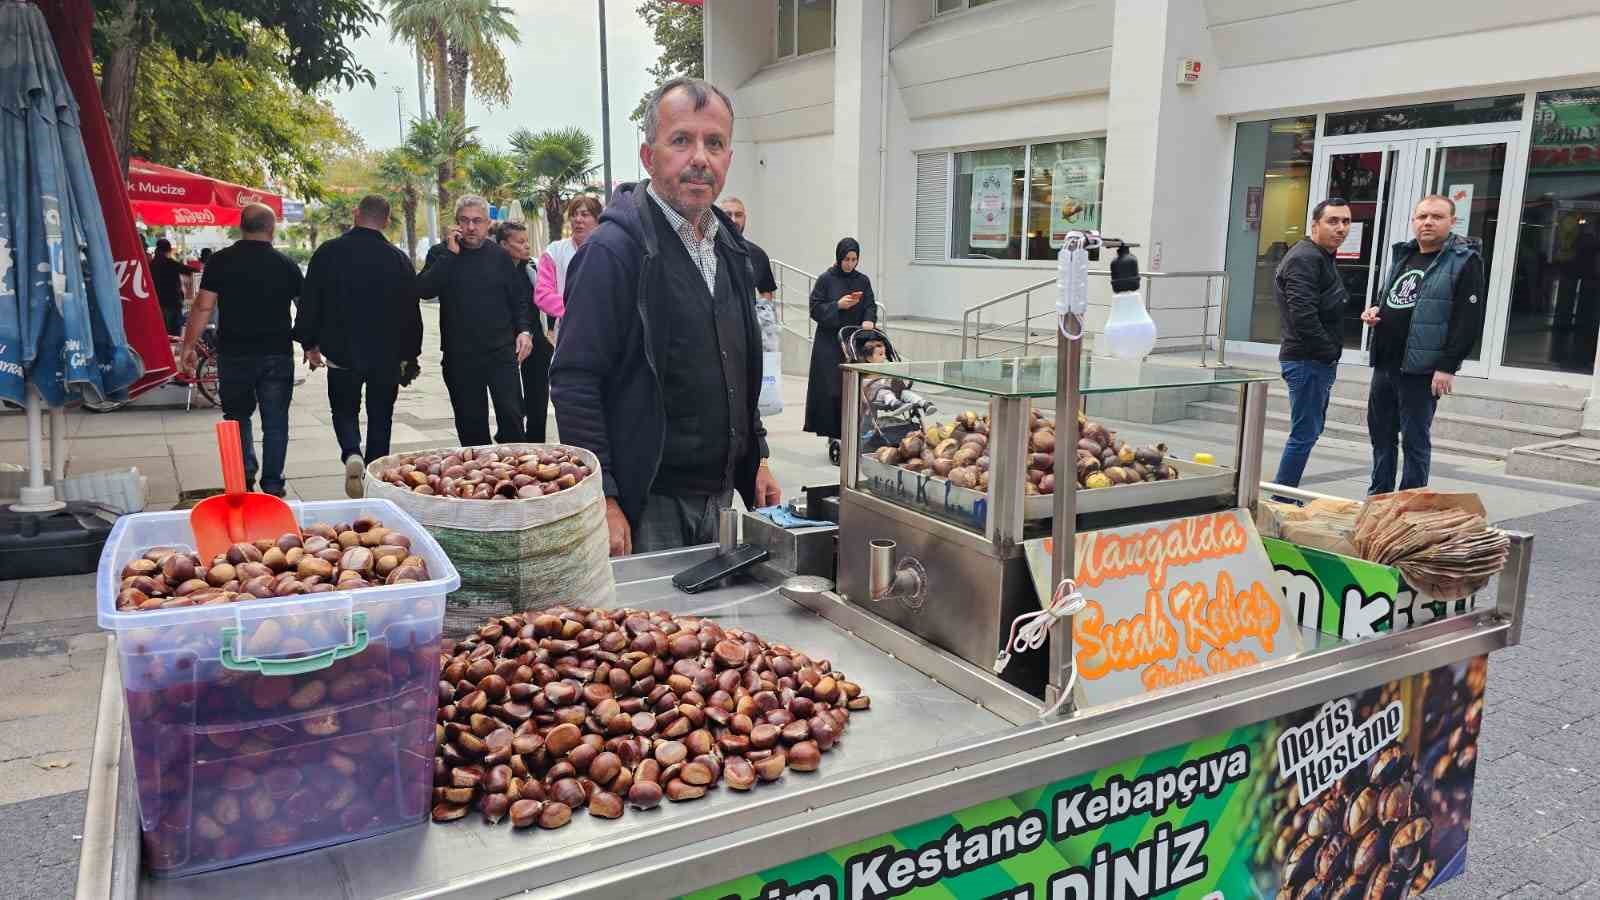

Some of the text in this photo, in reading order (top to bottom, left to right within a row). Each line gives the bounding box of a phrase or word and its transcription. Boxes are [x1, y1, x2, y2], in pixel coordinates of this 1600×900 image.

[138, 182, 186, 196] Mucize
[1299, 705, 1401, 800] Kestane
[850, 814, 1043, 900] Kestane
[1056, 748, 1248, 835] Kebapçıya
